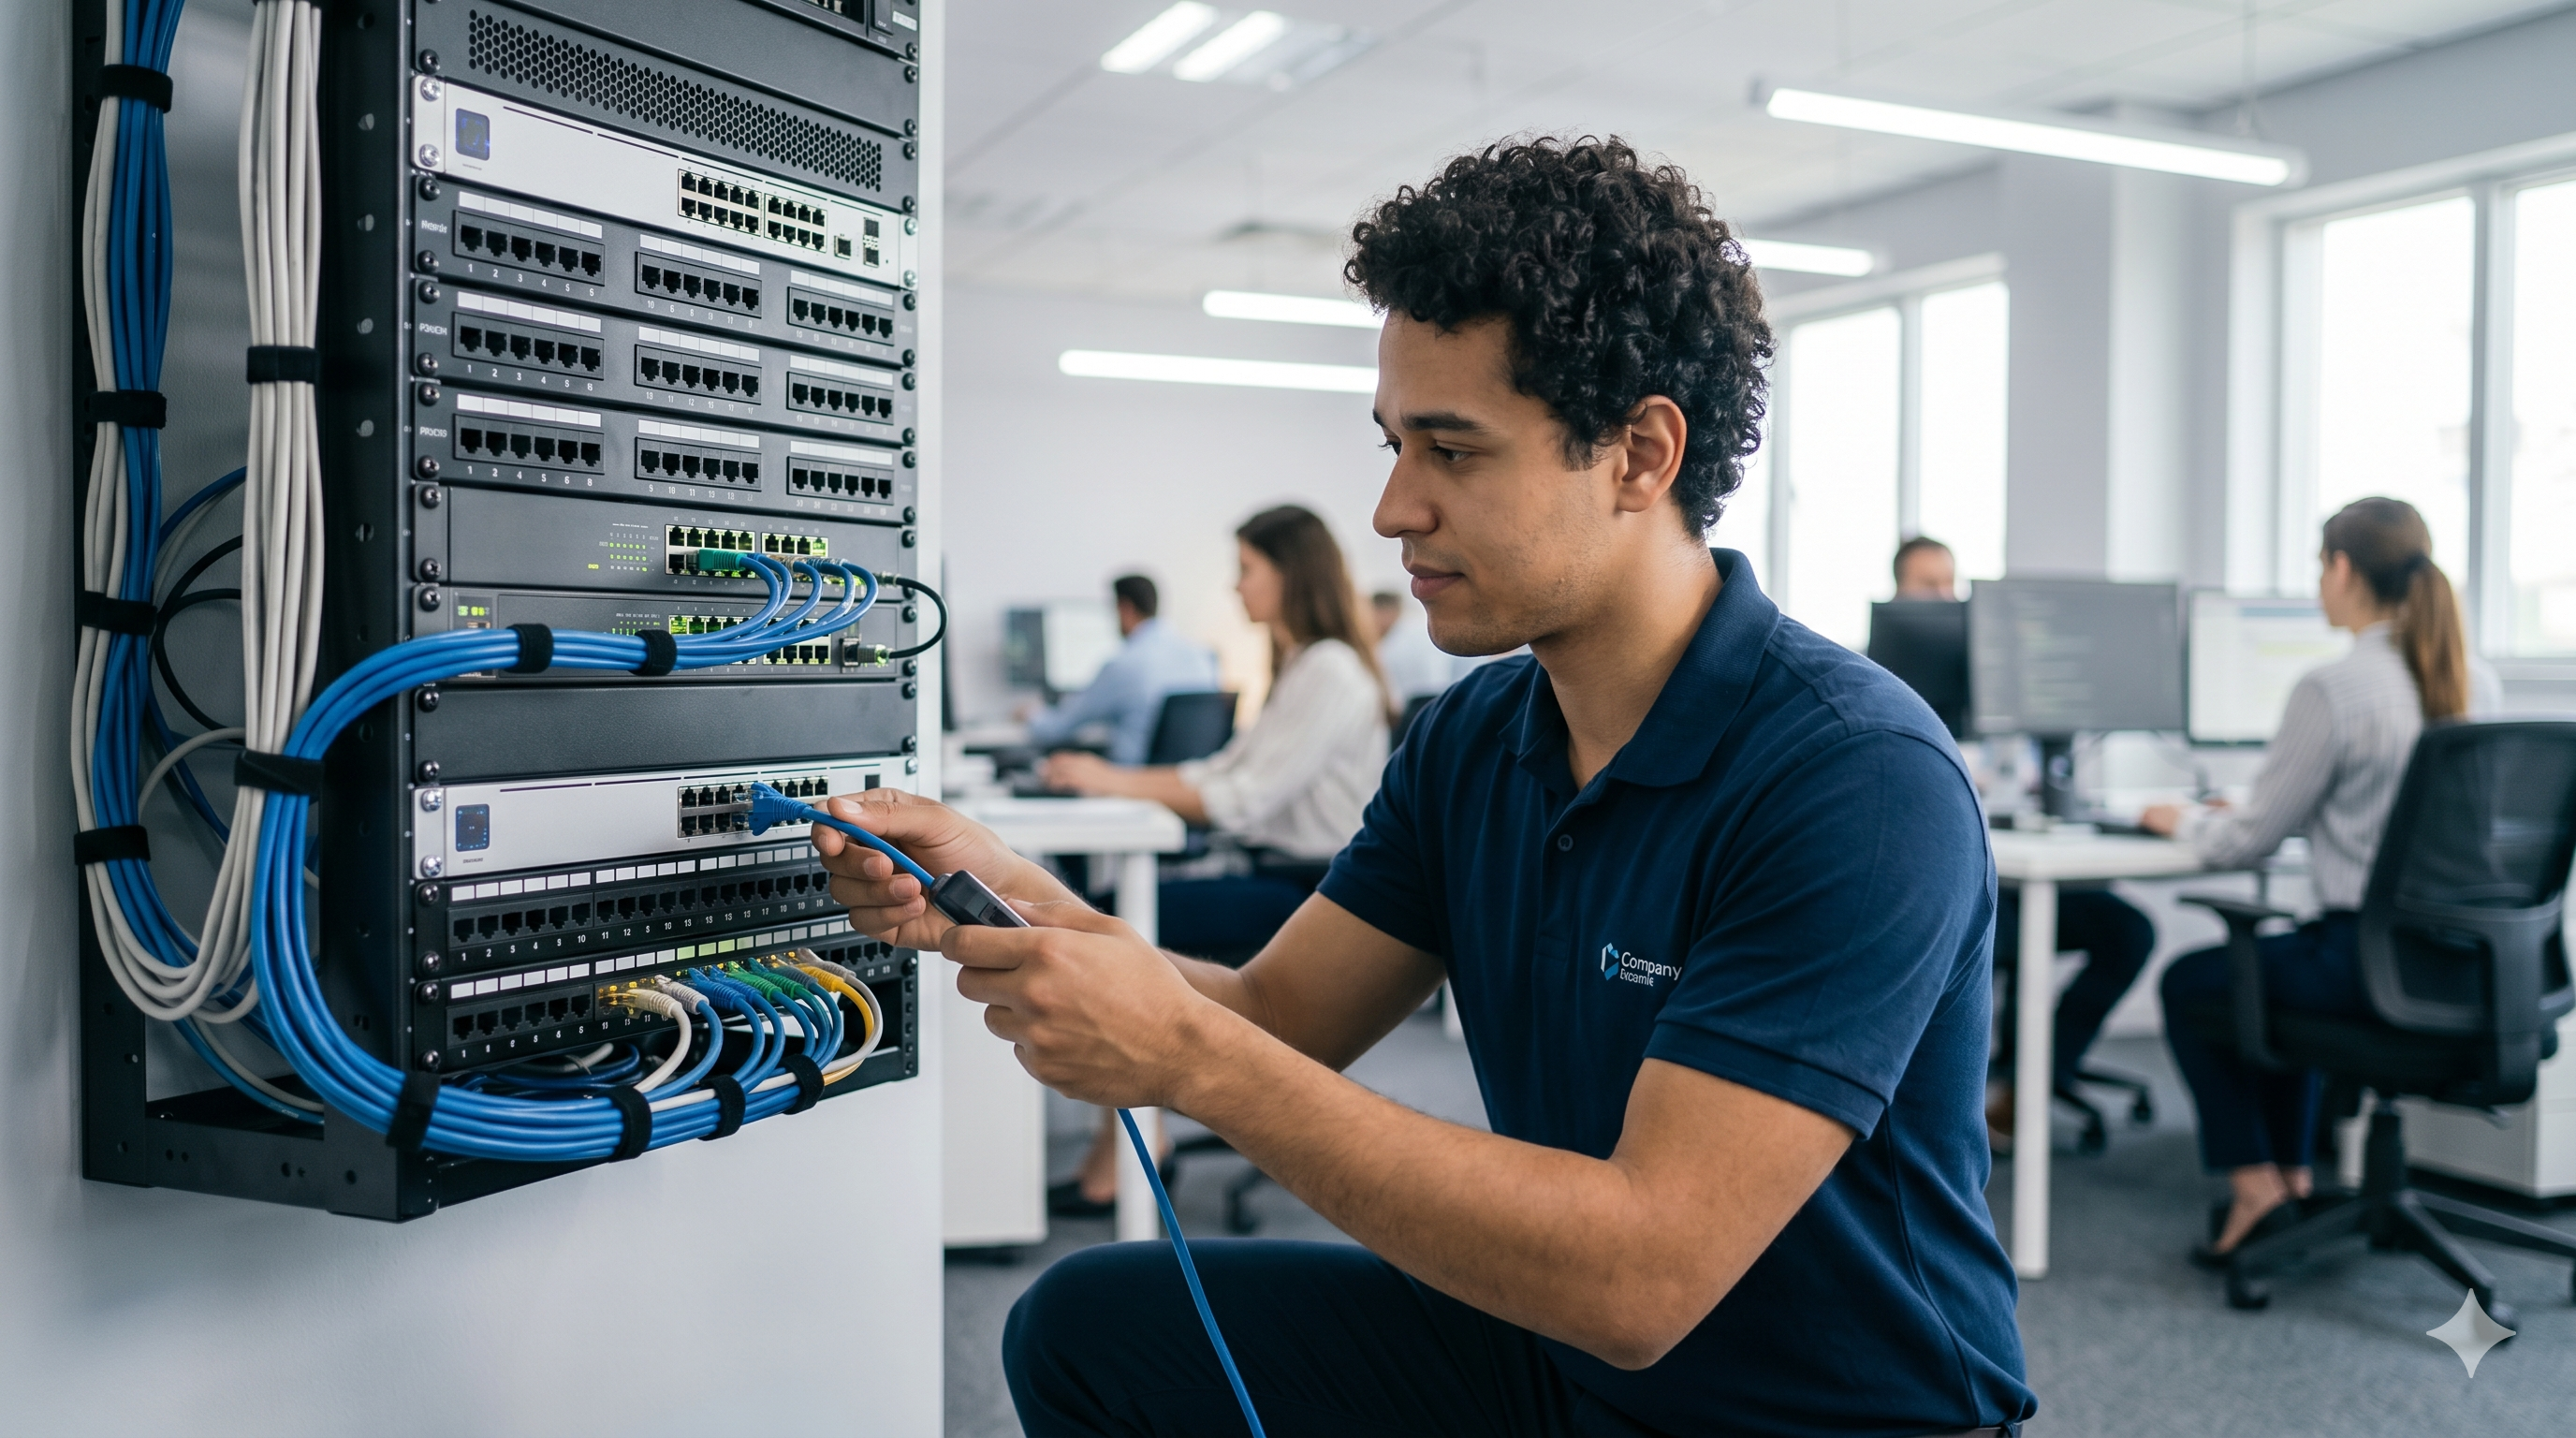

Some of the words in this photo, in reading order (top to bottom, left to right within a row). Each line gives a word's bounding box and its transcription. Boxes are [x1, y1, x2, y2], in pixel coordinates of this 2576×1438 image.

[647, 300, 655, 309] 10
[577, 934, 586, 944] 10
[601, 931, 609, 940] 11
[623, 928, 631, 936] 12
[664, 921, 672, 931] 10
[1621, 951, 1682, 980] Company
